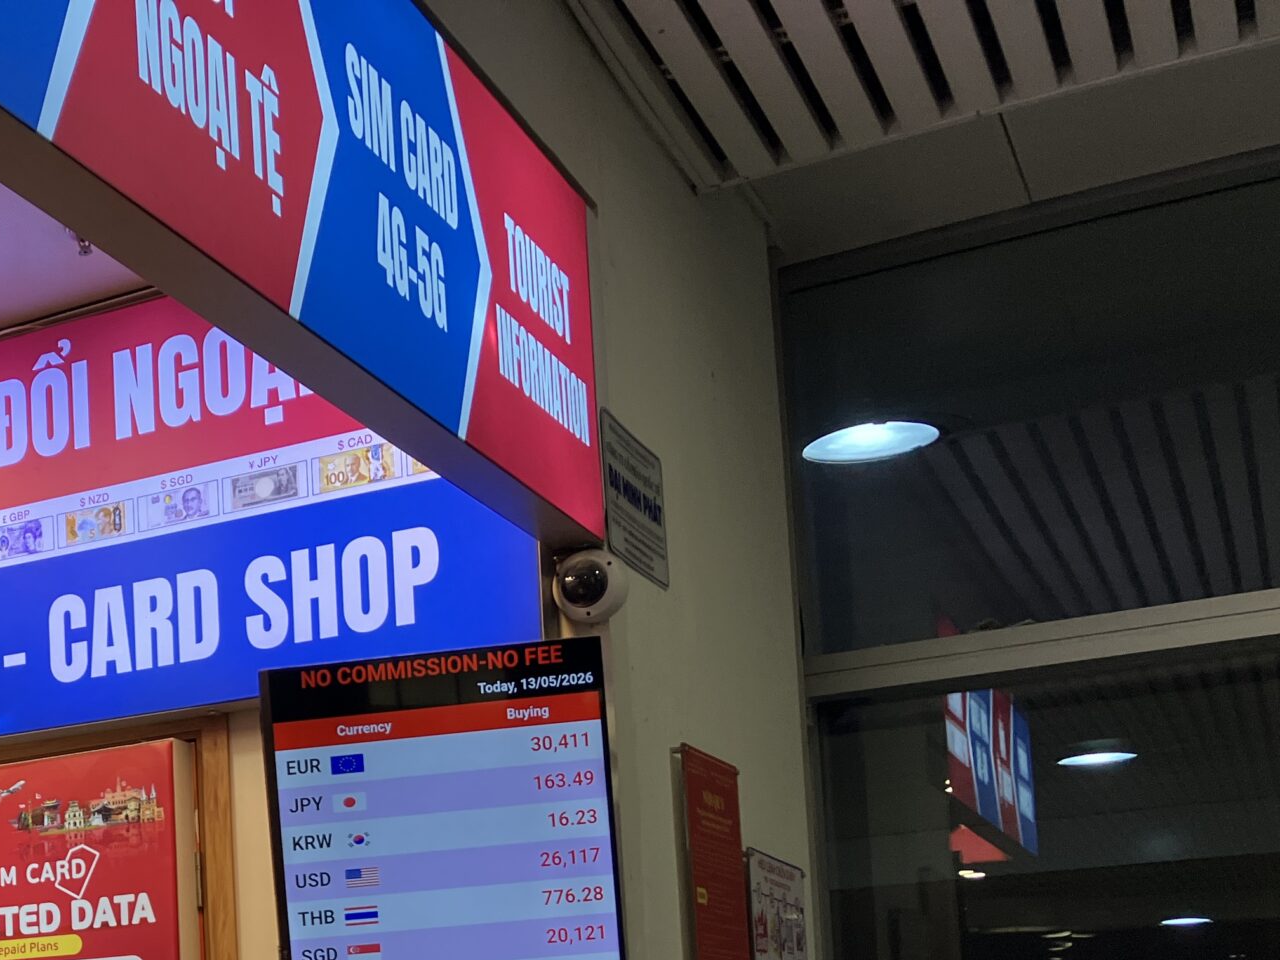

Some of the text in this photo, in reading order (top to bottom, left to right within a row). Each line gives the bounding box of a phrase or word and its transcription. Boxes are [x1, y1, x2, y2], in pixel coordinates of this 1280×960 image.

[135, 0, 284, 218] NGOẠI TỆ
[345, 43, 458, 230] SIM CARD
[377, 191, 448, 333] 4G-5G
[504, 212, 571, 345] TOURIST
[495, 302, 590, 447] INFORMATION
[257, 455, 279, 468] JPY
[337, 434, 373, 450] $ CAD
[79, 492, 110, 507] $ NZD
[160, 474, 193, 490] $ SGD
[8, 509, 31, 522] GBP
[2, 651, 28, 669] -
[48, 568, 220, 684] CARD
[244, 525, 442, 652] SHOP
[300, 645, 563, 689] NO COMMISSION-NO FEE
[477, 672, 594, 694] Today, 13/05/2026
[336, 705, 549, 737] Currency Buying
[286, 732, 590, 776] EUR 30,411
[289, 771, 595, 814] JPY 163.49
[292, 809, 598, 851] KRW 16.23
[26, 858, 86, 885] CARD
[295, 847, 601, 889] USD 26,117
[71, 892, 156, 931] DATA
[298, 886, 604, 927] THB 776.28
[29, 941, 59, 953] Plans
[546, 925, 606, 946] 20,121
